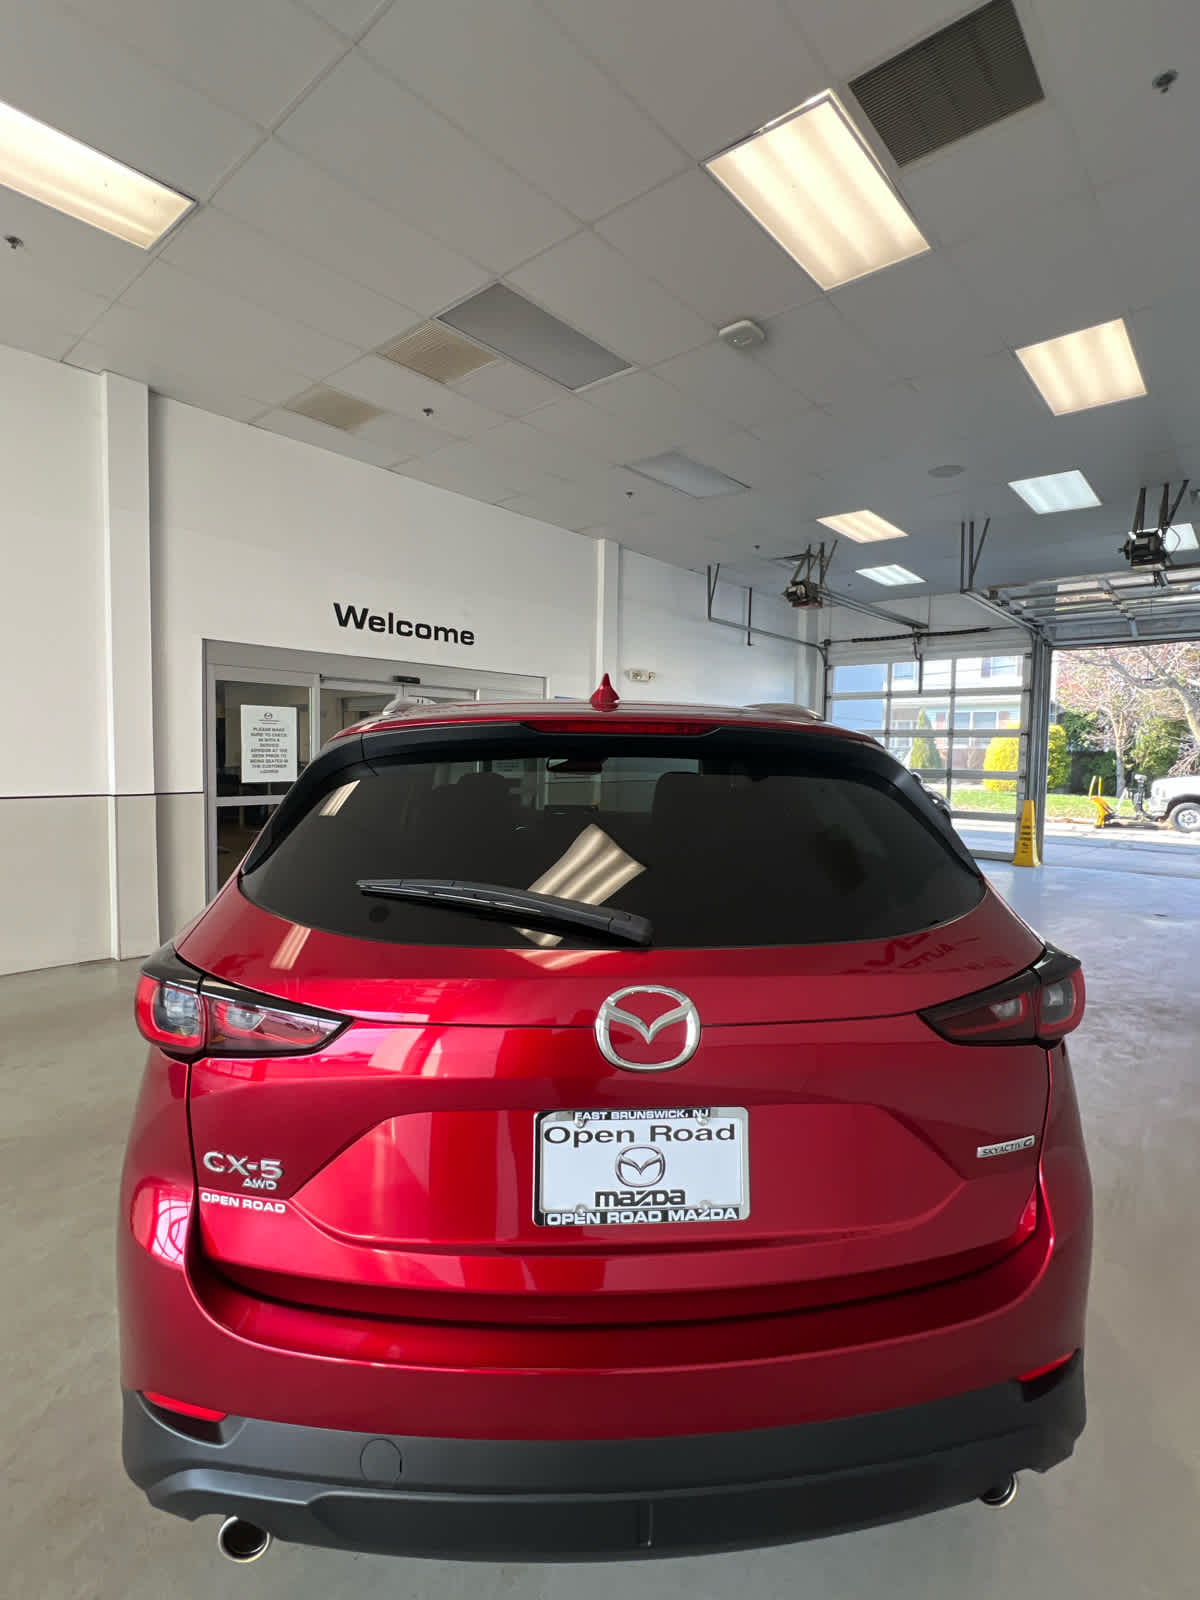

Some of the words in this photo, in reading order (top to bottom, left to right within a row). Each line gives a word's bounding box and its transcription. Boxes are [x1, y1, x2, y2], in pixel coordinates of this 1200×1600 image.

[333, 602, 474, 645] Welcome
[574, 1111, 607, 1121] EAST
[612, 1109, 689, 1120] BRUNSWICK,
[693, 1109, 709, 1118] NJ
[544, 1126, 634, 1147] Open
[650, 1124, 735, 1142] Road
[203, 1151, 283, 1179] CX-5
[242, 1178, 277, 1190] AWD
[201, 1192, 239, 1207] OPEN
[242, 1199, 286, 1213] ROAD
[547, 1212, 600, 1225] OPEN
[607, 1210, 660, 1224] ROAD
[668, 1207, 737, 1221] MAZDA
